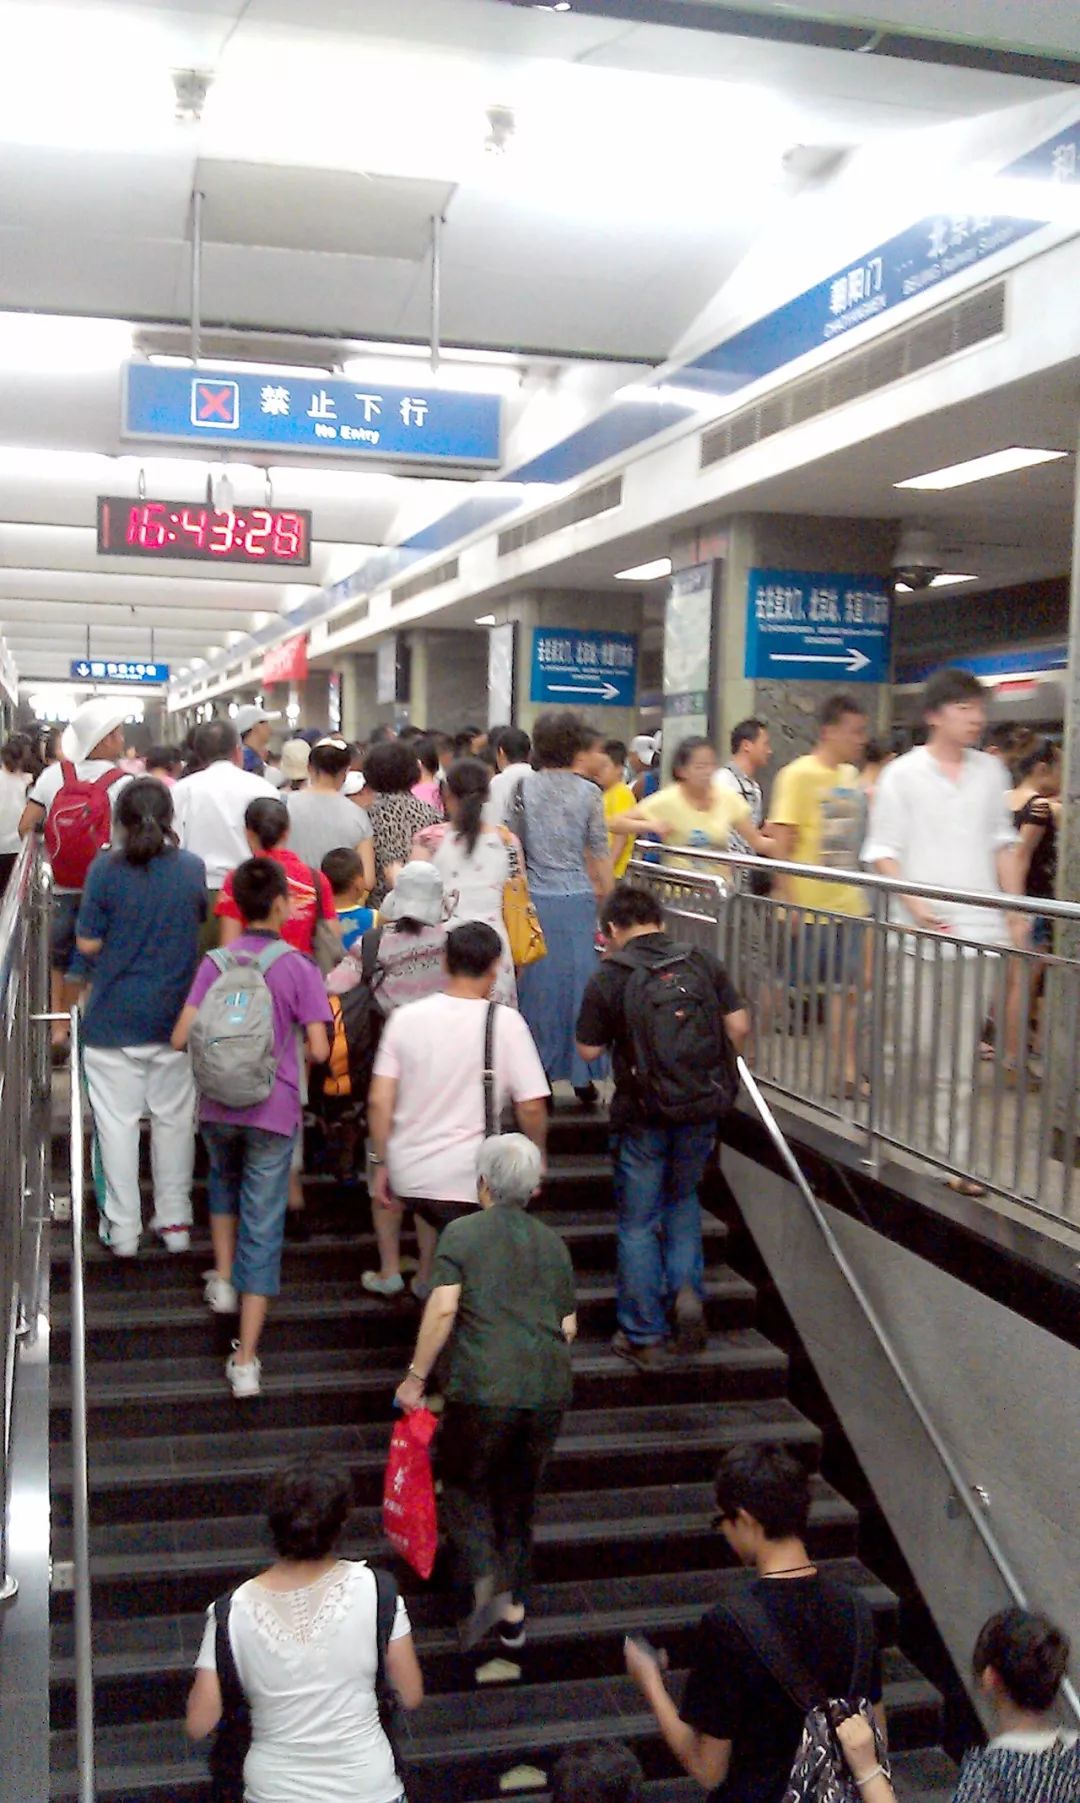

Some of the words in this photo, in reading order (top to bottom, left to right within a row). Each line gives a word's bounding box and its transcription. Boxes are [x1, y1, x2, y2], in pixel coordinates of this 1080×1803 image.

[260, 385, 429, 427] 禁止下行
[315, 423, 337, 439] No
[340, 425, 381, 445] Entry
